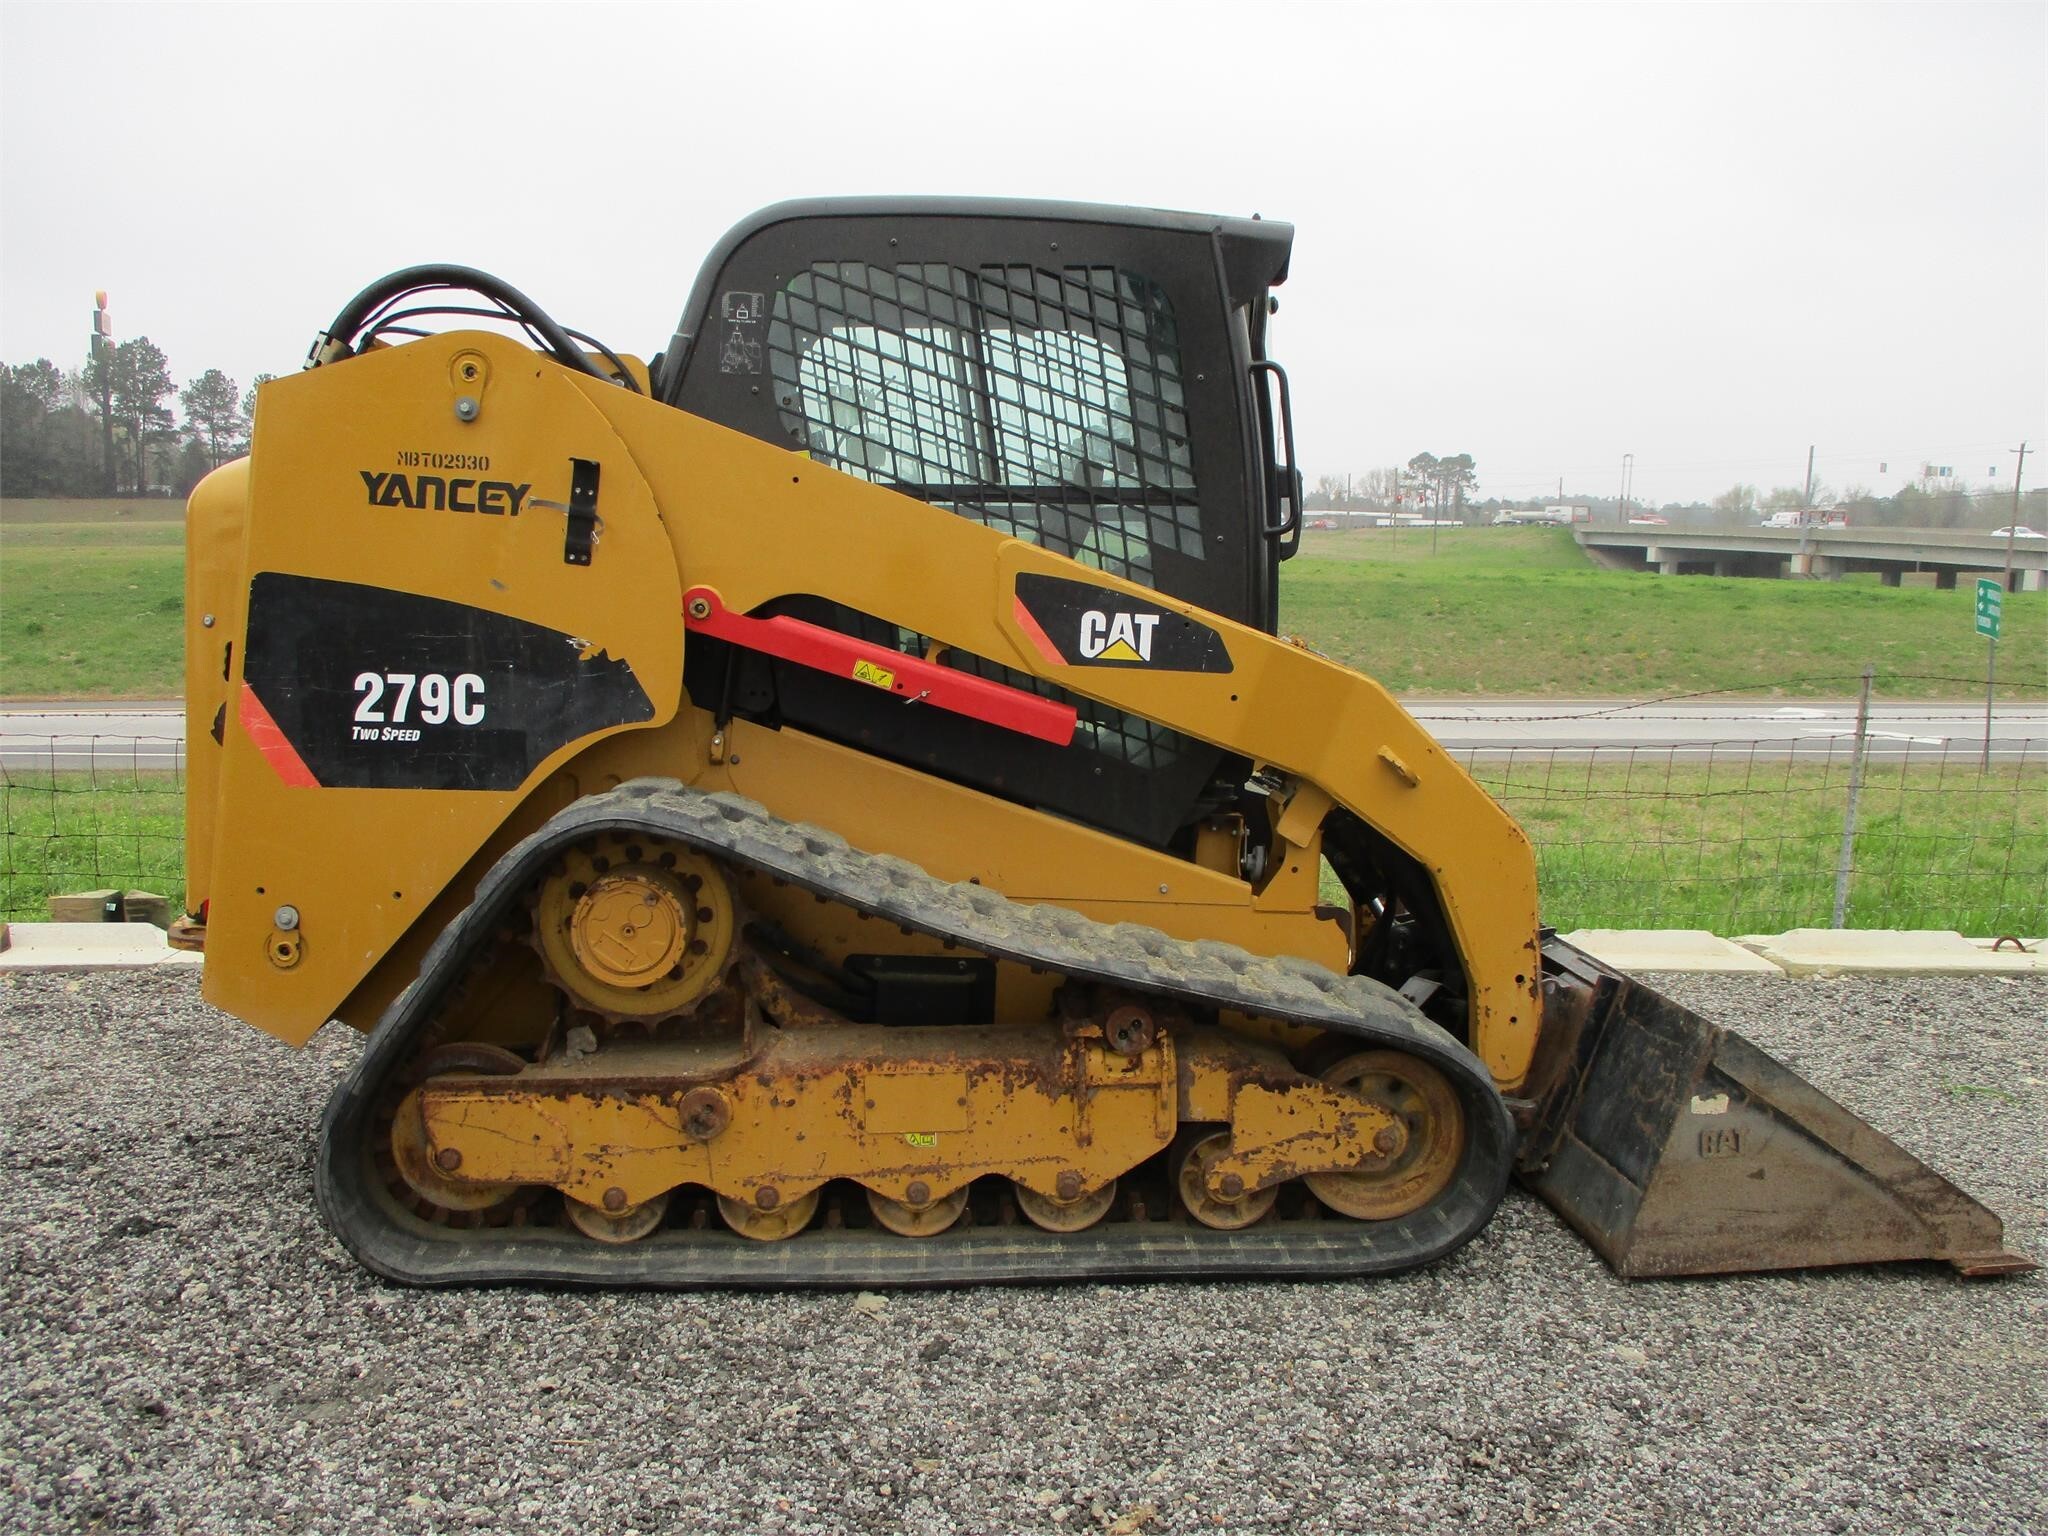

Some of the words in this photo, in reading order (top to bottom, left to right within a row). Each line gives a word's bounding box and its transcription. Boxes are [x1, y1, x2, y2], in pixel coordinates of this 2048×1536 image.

[359, 471, 532, 516] YANCEY
[1079, 610, 1160, 662] CAT
[353, 671, 486, 726] 279C
